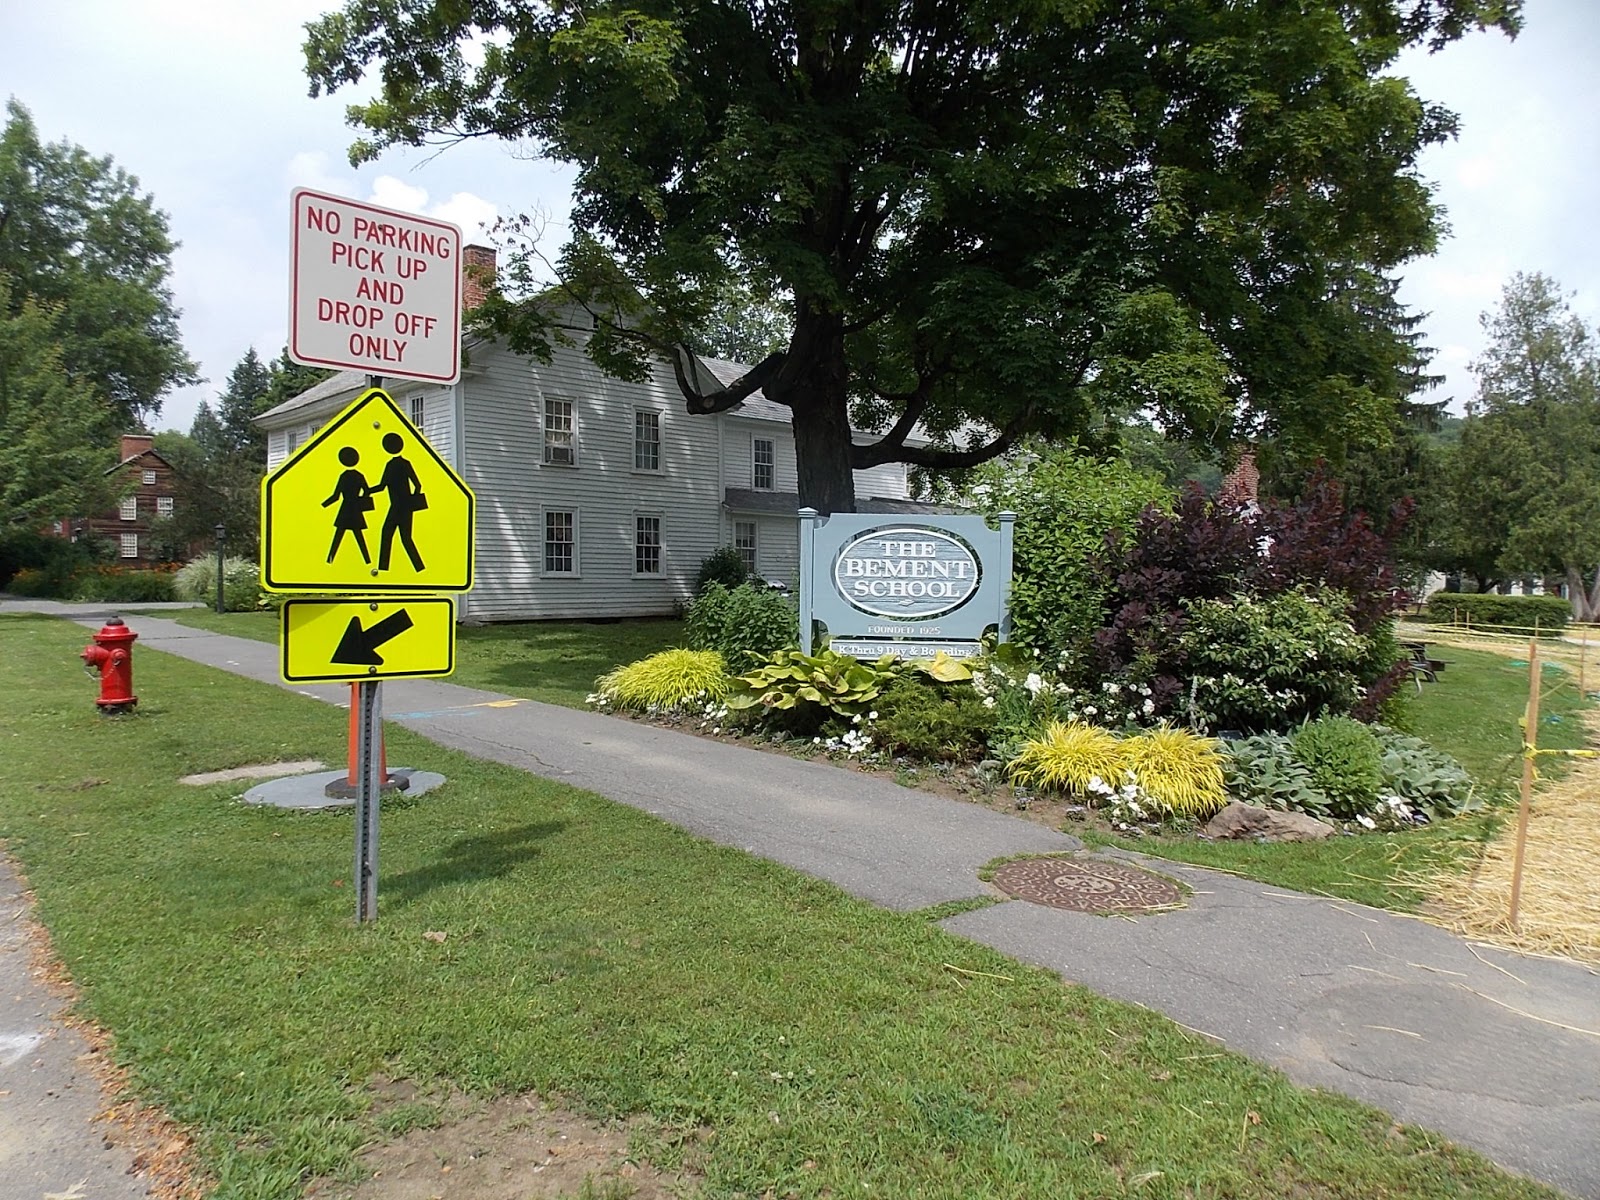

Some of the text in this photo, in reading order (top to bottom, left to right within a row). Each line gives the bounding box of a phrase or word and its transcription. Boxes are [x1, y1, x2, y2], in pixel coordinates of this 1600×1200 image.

[307, 206, 450, 259] NO PARKING
[332, 241, 427, 280] PICK UP
[356, 277, 404, 305] AND
[318, 298, 437, 338] DROP OFF
[349, 333, 408, 362] ONLY
[879, 541, 936, 558] THE
[844, 558, 971, 579] BEMENT
[854, 580, 960, 598] SCHOOL
[867, 625, 941, 635] FOUNDED 1925
[838, 645, 973, 659] K Thru 9 Day & Bording
